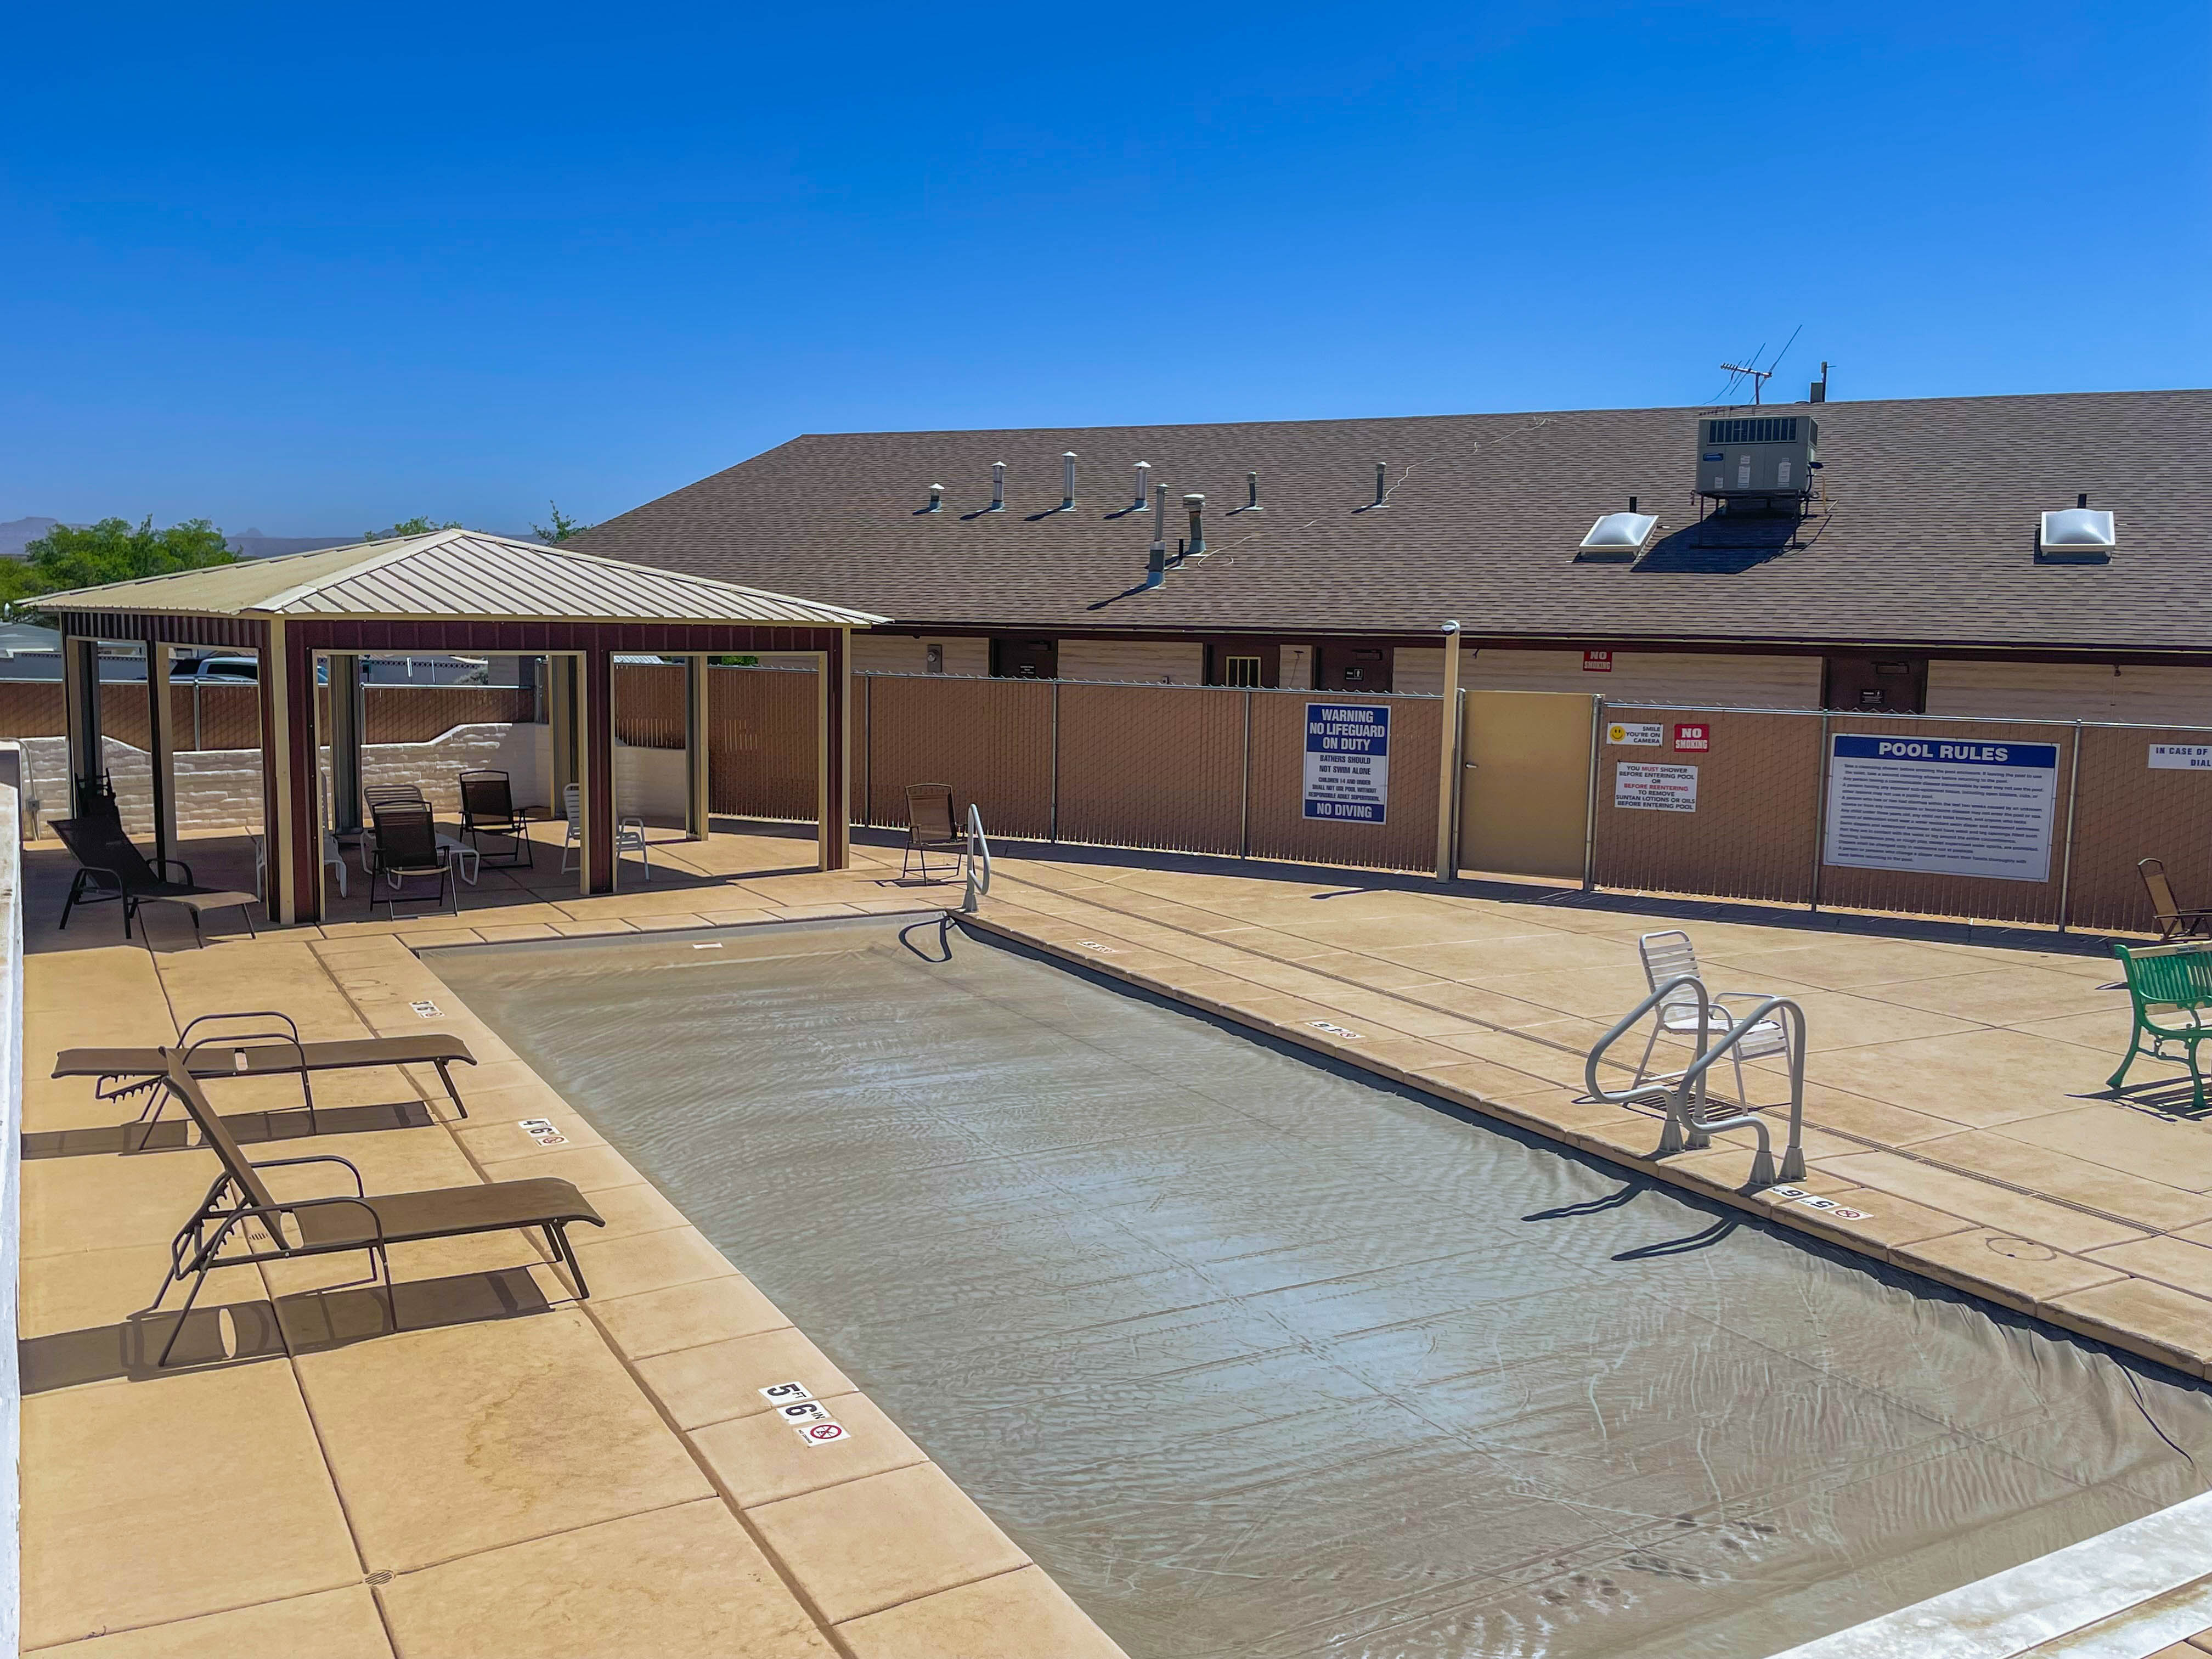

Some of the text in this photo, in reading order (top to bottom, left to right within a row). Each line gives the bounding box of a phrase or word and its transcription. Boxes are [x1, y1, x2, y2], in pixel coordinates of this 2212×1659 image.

[1590, 651, 1607, 659] NO
[1584, 661, 1611, 669] SMOKING
[1322, 708, 1374, 723] WARNING
[1310, 722, 1385, 738] NO LIFEGUARD
[1681, 728, 1702, 738] NO
[1323, 737, 1371, 751] ON DUTY
[1675, 740, 1708, 749] SMOKING
[1878, 742, 2008, 762] POOL RULES
[1319, 754, 1346, 763] BATHERS
[1352, 767, 1371, 775] ALONE
[1317, 803, 1372, 819] NO DIVING
[767, 1384, 800, 1396] 5
[786, 1403, 826, 1420] 6 IN
